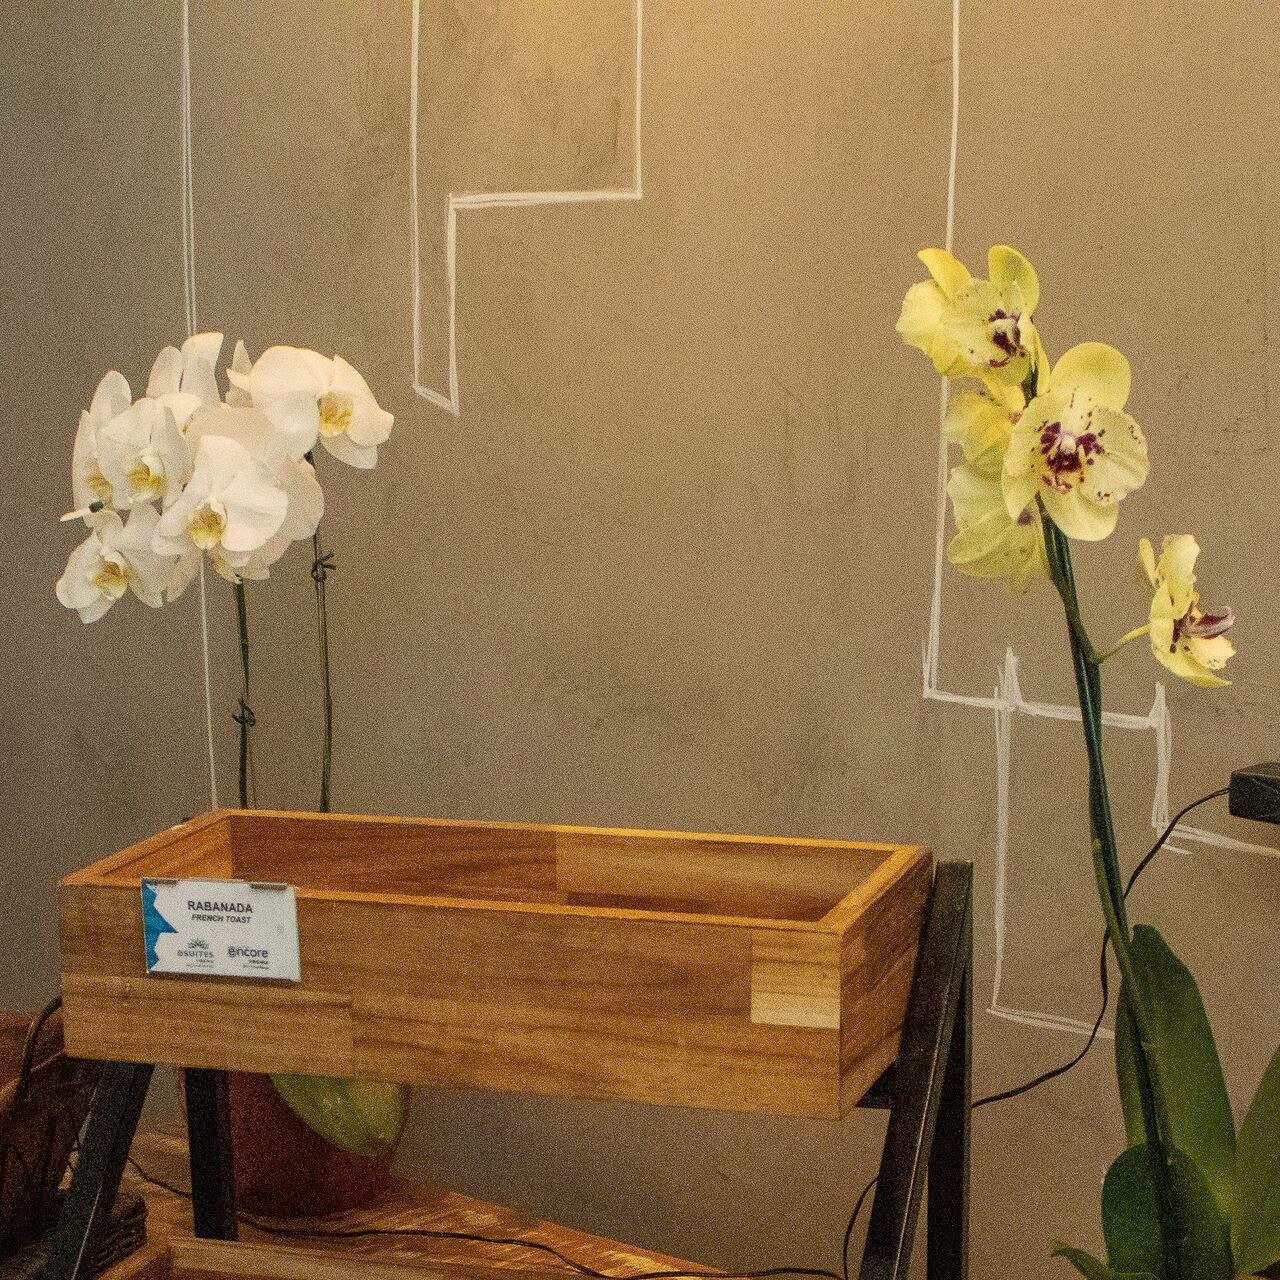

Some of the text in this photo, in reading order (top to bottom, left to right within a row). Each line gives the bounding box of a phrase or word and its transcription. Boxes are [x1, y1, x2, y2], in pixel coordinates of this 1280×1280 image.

[187, 900, 253, 914] RABANADA
[191, 914, 251, 924] FRENCH TOAST
[228, 946, 269, 959] encore
